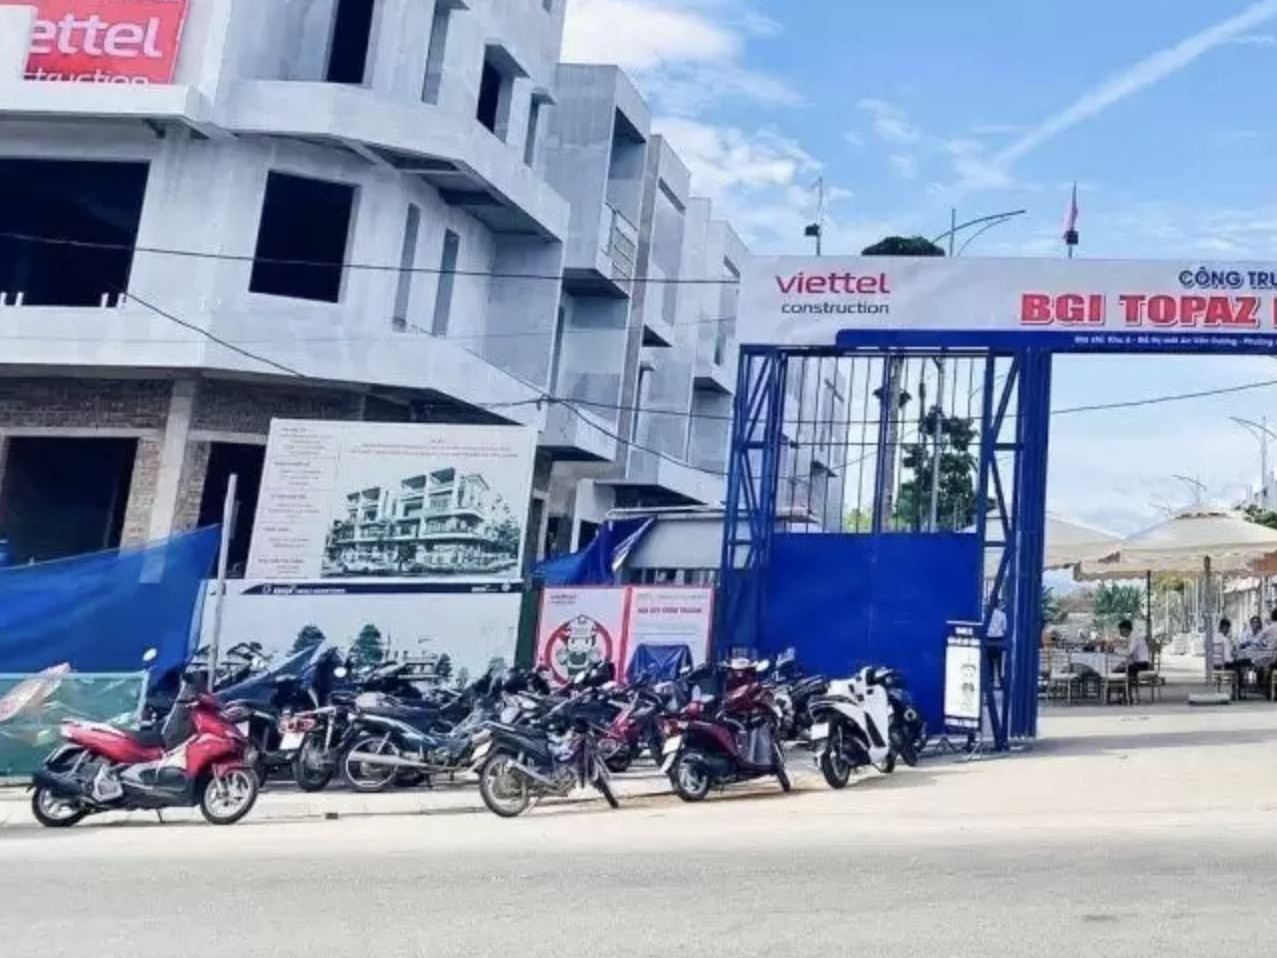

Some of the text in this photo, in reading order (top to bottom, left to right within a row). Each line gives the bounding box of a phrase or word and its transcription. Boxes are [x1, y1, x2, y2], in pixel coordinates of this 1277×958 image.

[775, 271, 891, 294] viettel
[1178, 266, 1244, 289] CÔNG
[781, 302, 889, 315] construction
[1020, 294, 1106, 325] BGI
[1118, 294, 1261, 329] TOPAZ
